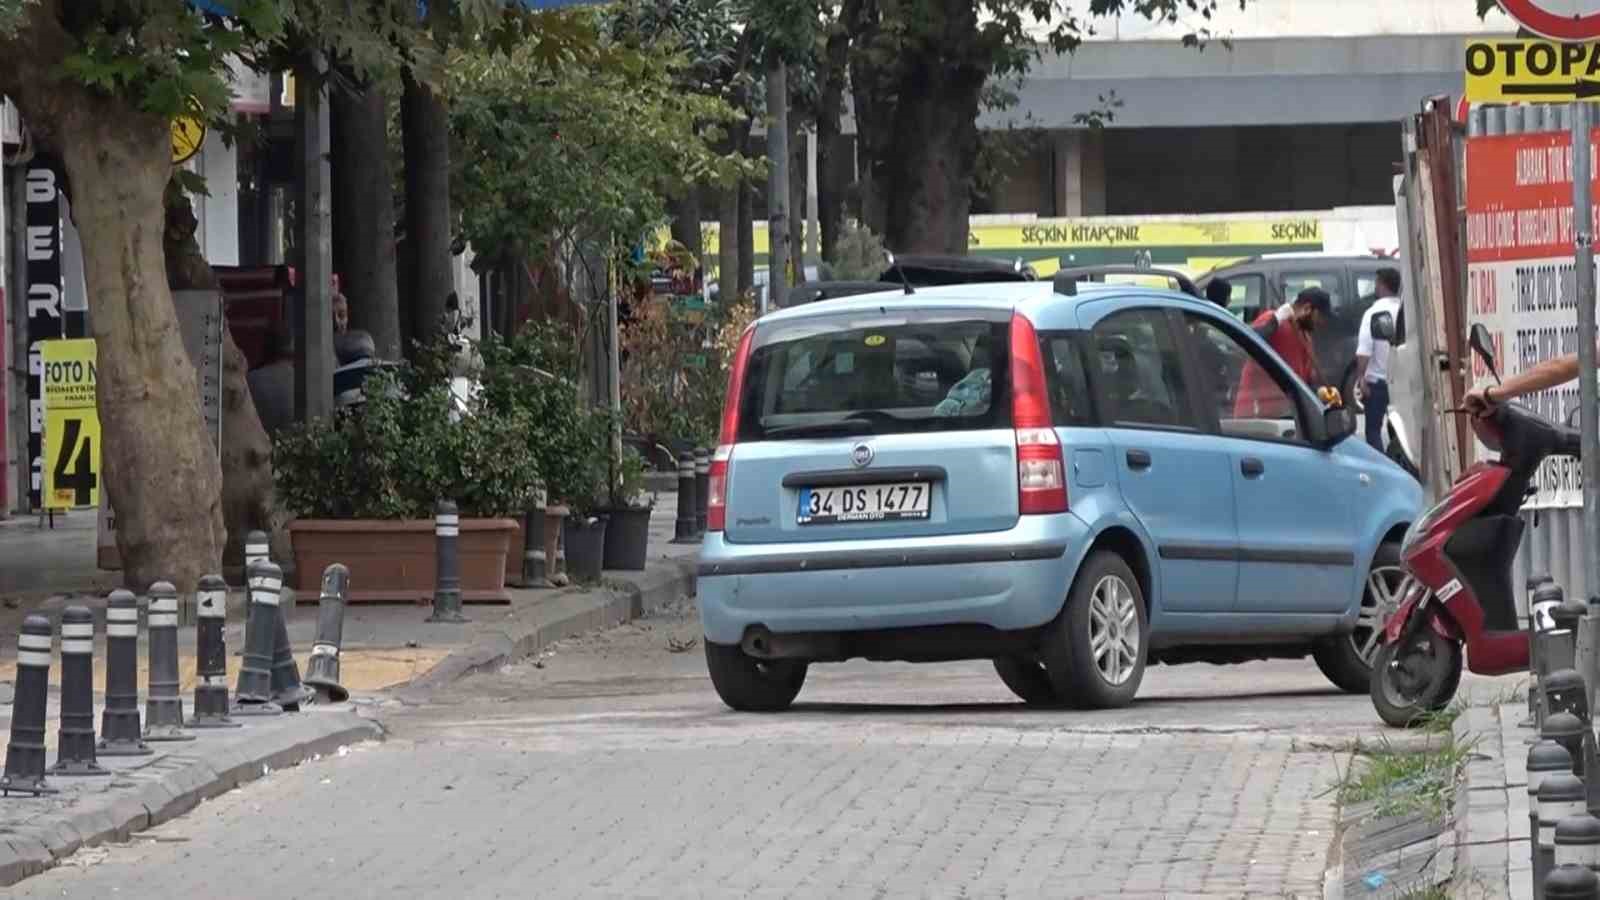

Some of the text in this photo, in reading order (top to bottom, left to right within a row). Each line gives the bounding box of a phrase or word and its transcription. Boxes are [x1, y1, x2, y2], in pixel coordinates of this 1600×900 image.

[1022, 222, 1140, 245] SEÇKİN KİTAPÇINIZ
[1271, 219, 1317, 242] SEÇKİN
[45, 361, 82, 382] FOTO
[54, 419, 97, 505] 4
[810, 486, 923, 515] 34 DS 1477
